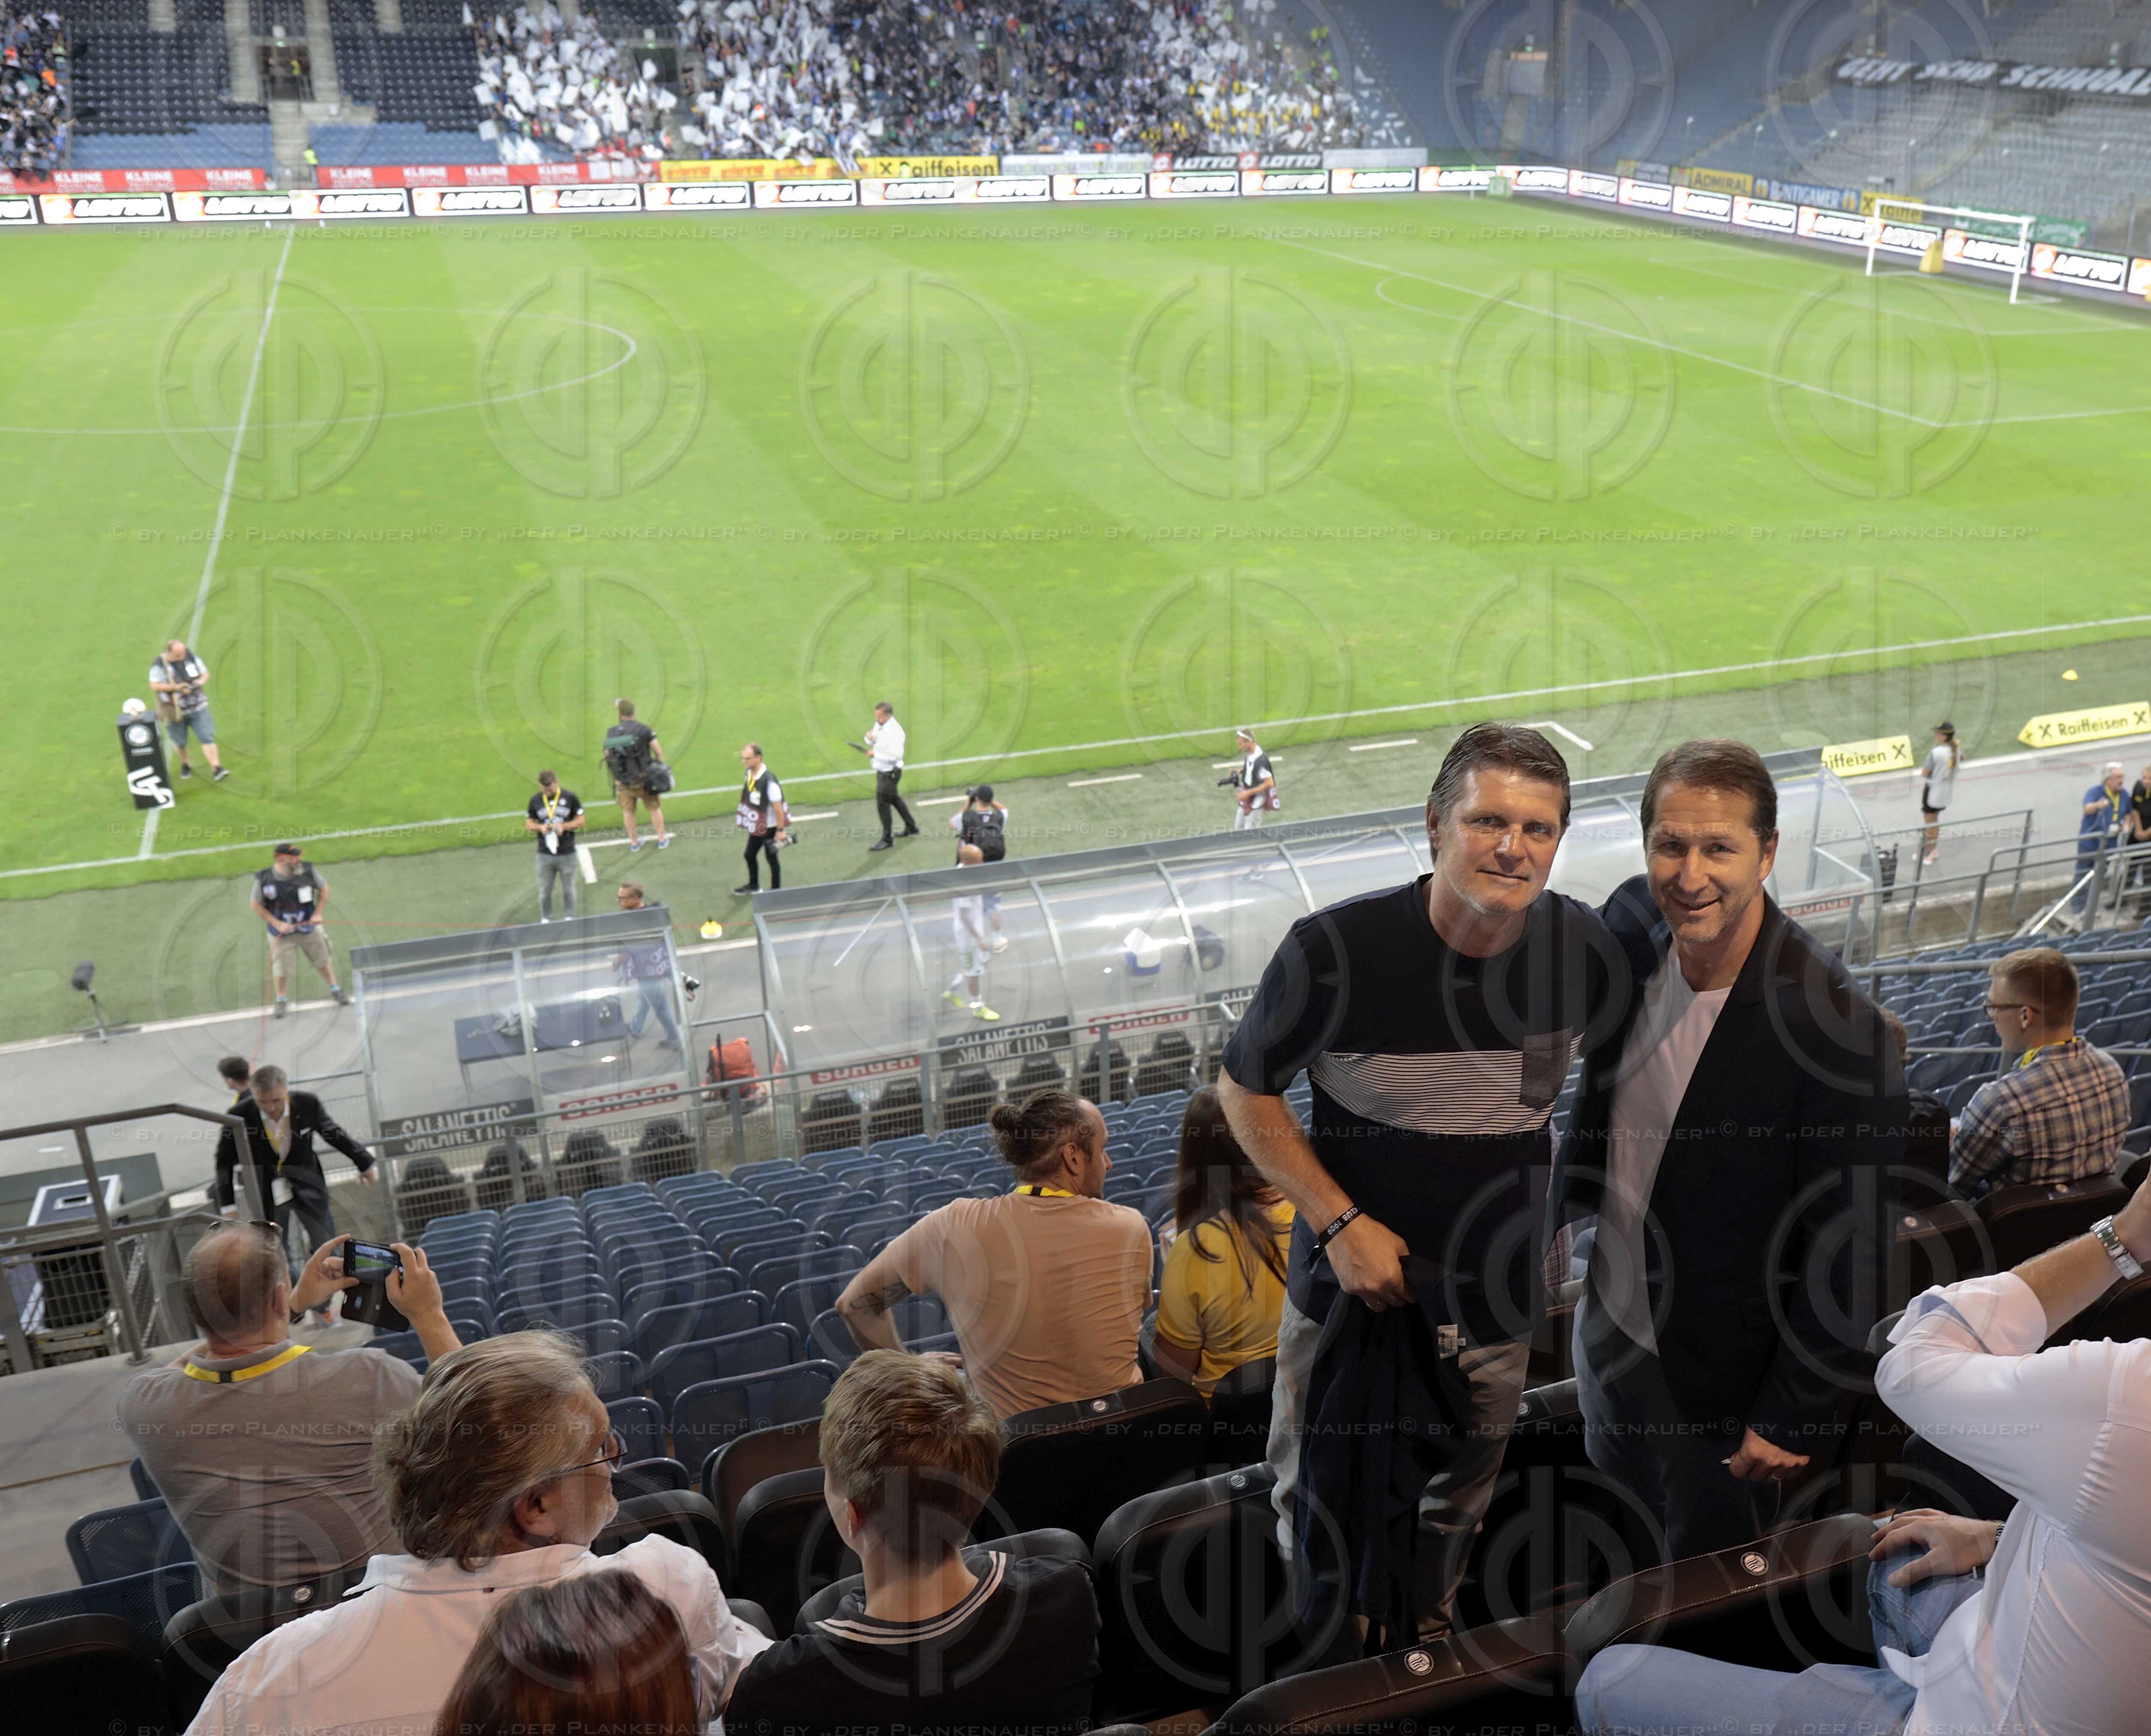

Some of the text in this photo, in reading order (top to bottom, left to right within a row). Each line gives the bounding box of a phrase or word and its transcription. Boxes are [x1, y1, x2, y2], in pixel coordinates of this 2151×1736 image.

[1172, 156, 1238, 170] LOTTO
[1259, 155, 1322, 168] LOTTO
[1694, 172, 1748, 194] ADMIRAL
[2058, 717, 2129, 737] Raiffeisen
